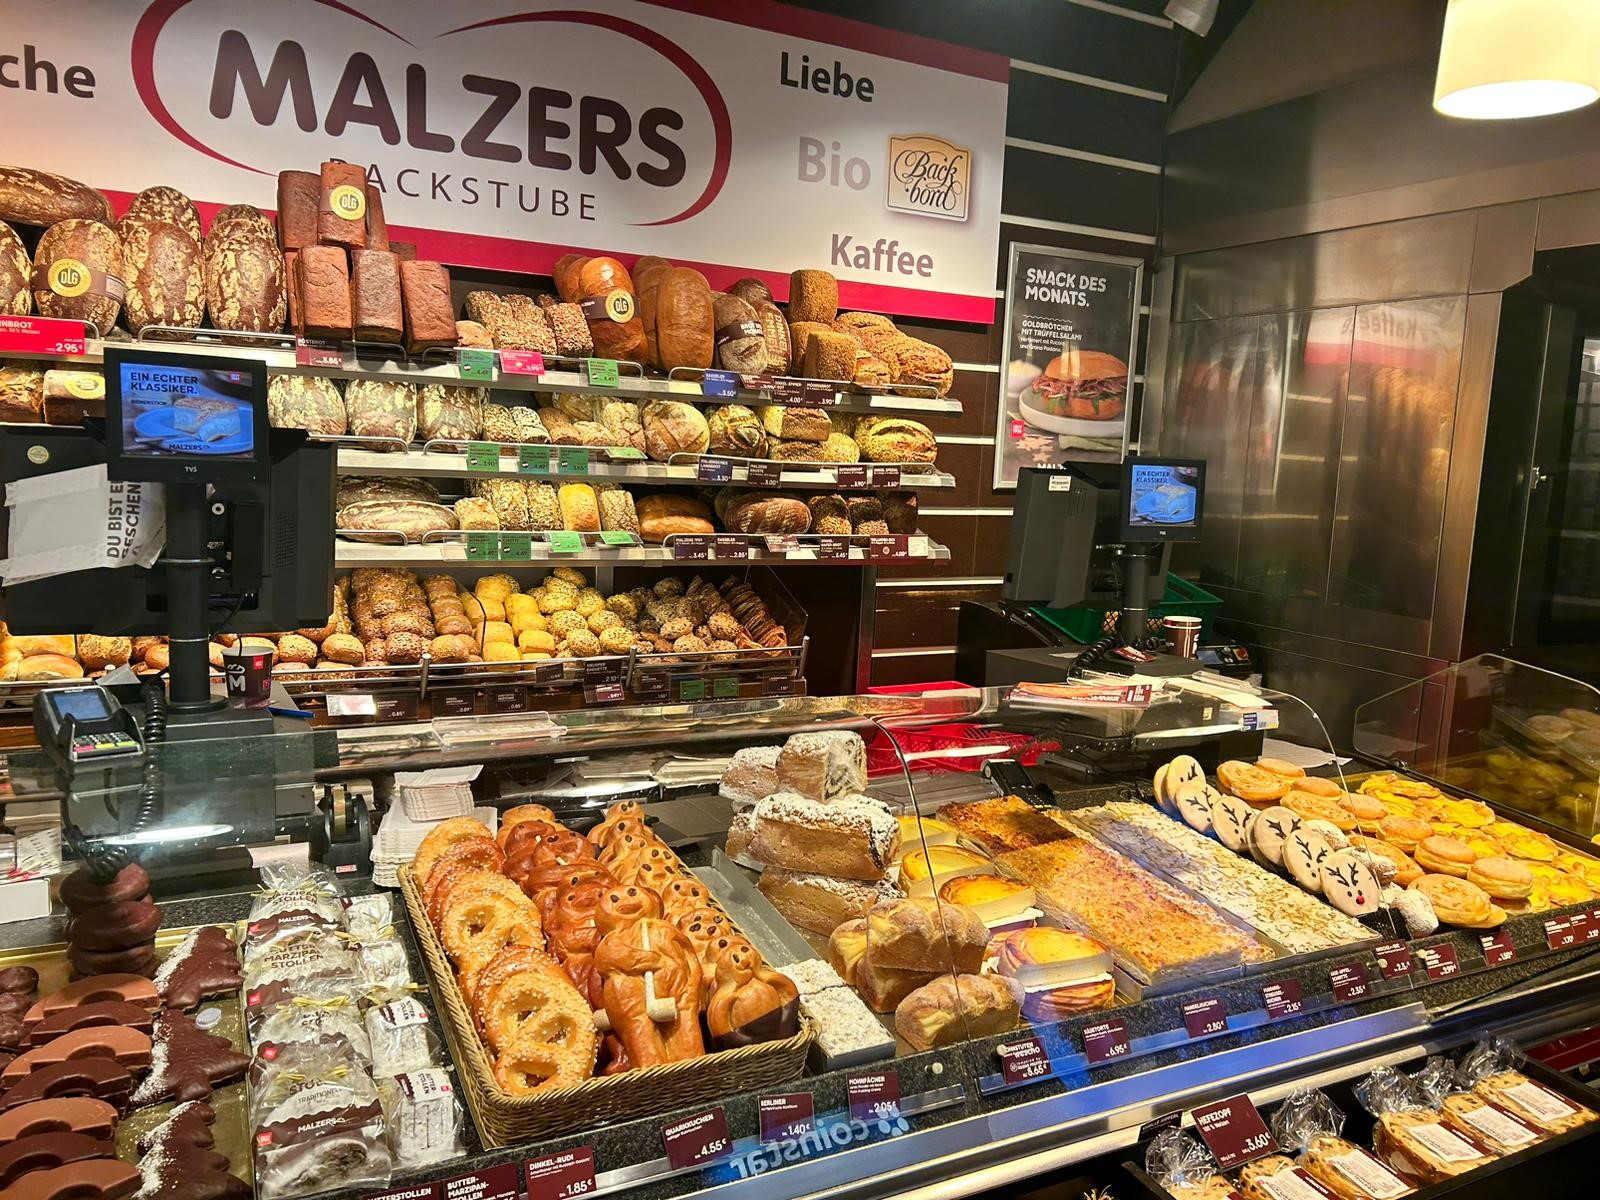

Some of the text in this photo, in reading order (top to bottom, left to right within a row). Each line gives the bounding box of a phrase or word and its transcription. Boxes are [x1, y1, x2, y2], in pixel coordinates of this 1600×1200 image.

[780, 51, 874, 102] Liebe
[209, 29, 686, 188] MALZERS
[799, 137, 871, 191] Bio
[330, 157, 596, 221] ACKSTUBE
[831, 234, 934, 277] Kaffee
[61, 269, 78, 285] DLG
[1026, 268, 1106, 292] SNACK DES
[1025, 285, 1090, 307] MONATS.
[1021, 328, 1032, 336] MIT
[131, 372, 199, 385] EIN ECHTER
[108, 498, 122, 531] BIST
[122, 480, 141, 559] GESCHEN
[107, 536, 121, 558] DU
[265, 948, 321, 961] MARZIPA
[788, 1123, 810, 1135] 1.40€
[701, 1137, 727, 1156] 4.55€
[1245, 1132, 1271, 1151] 3.60€
[530, 1154, 574, 1170] DINKEL-RUDI
[447, 1176, 479, 1190] BUTTER-
[448, 1181, 489, 1199] MARZIPAN-
[567, 1179, 592, 1195] 1.85€
